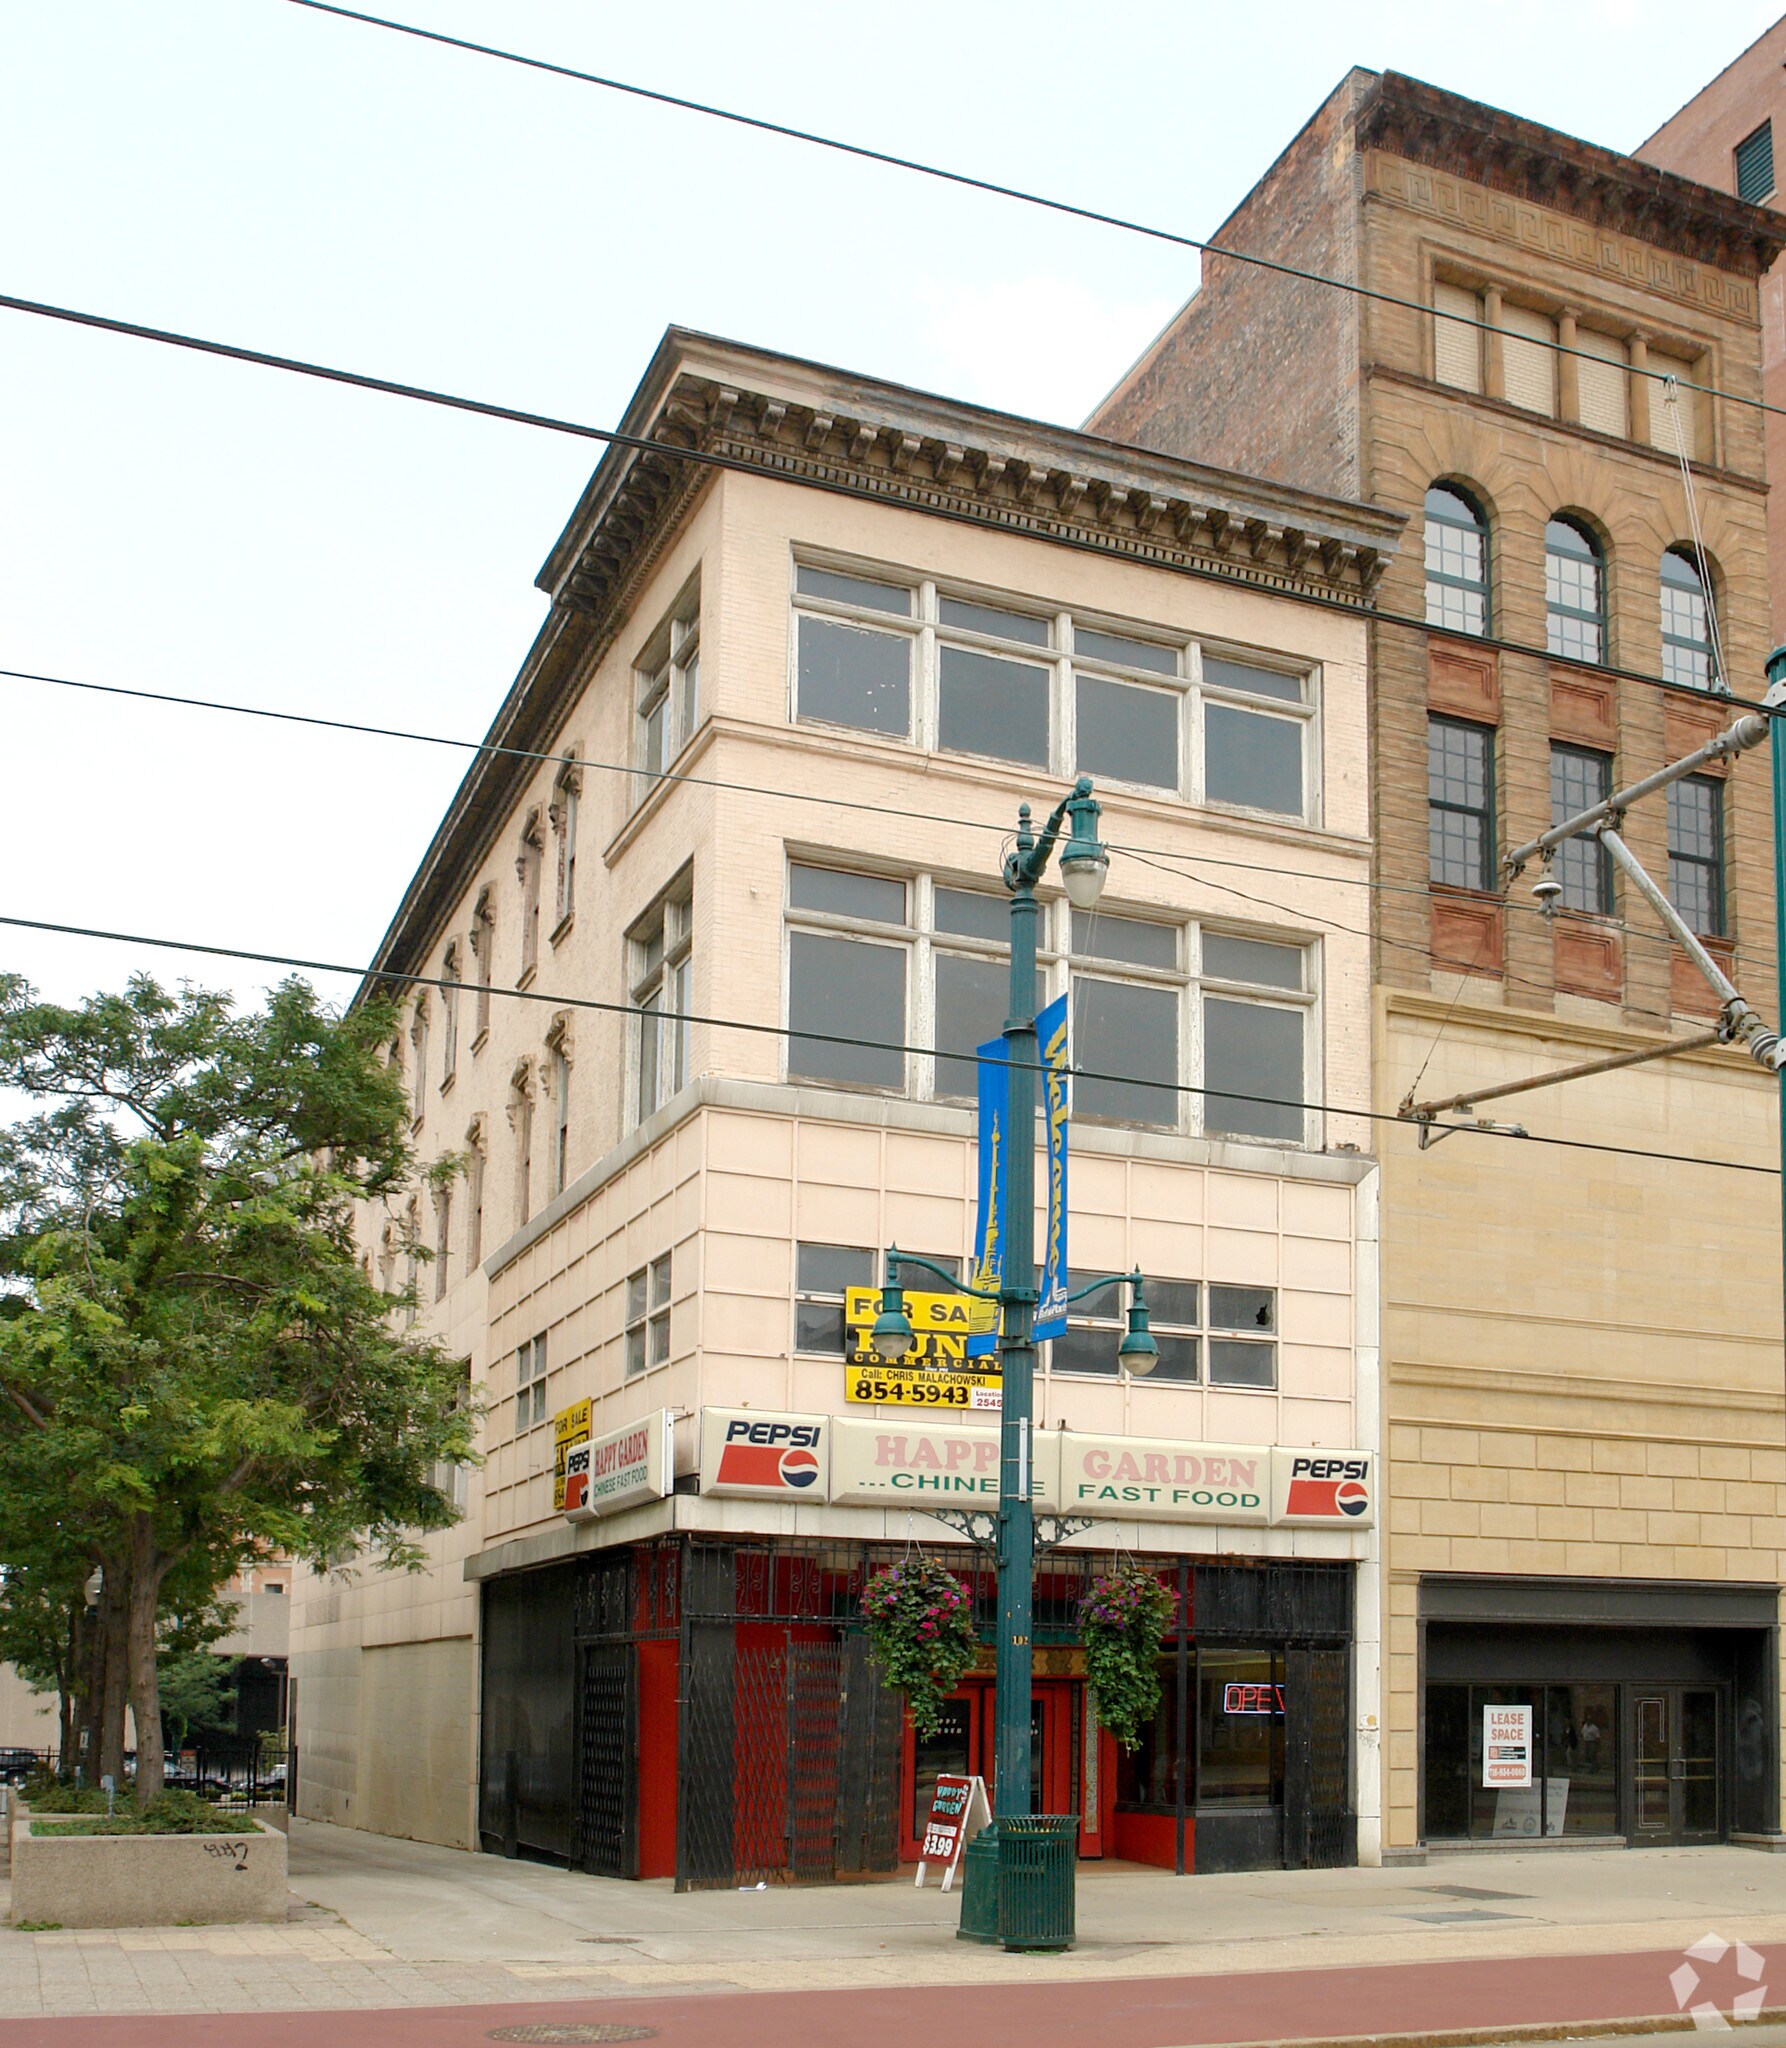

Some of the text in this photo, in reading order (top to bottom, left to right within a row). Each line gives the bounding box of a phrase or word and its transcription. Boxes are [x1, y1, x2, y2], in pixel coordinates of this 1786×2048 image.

[1044, 1017, 1067, 1278] Welcome
[854, 1352, 1002, 1370] COMMERCIAL
[861, 1368, 986, 1387] Call: CHRIS MALACHOWSKI
[855, 1380, 969, 1405] 854-5943
[555, 1407, 588, 1434] FOR SALE
[726, 1420, 821, 1448] PEPSI
[568, 1449, 590, 1475] PEPS
[594, 1441, 617, 1477] HAPPY
[619, 1428, 648, 1468] GARDEN
[874, 1435, 1258, 1488] HAPP GARDEN
[594, 1465, 648, 1498] CHINESE FAST FOOD
[1291, 1458, 1368, 1480] PEPSI
[1078, 1483, 1162, 1502] FAST
[1172, 1490, 1260, 1508] FOOD
[1491, 1713, 1524, 1725] LEASE
[1491, 1729, 1524, 1741] SPACE
[923, 1834, 953, 1857] $3.99
